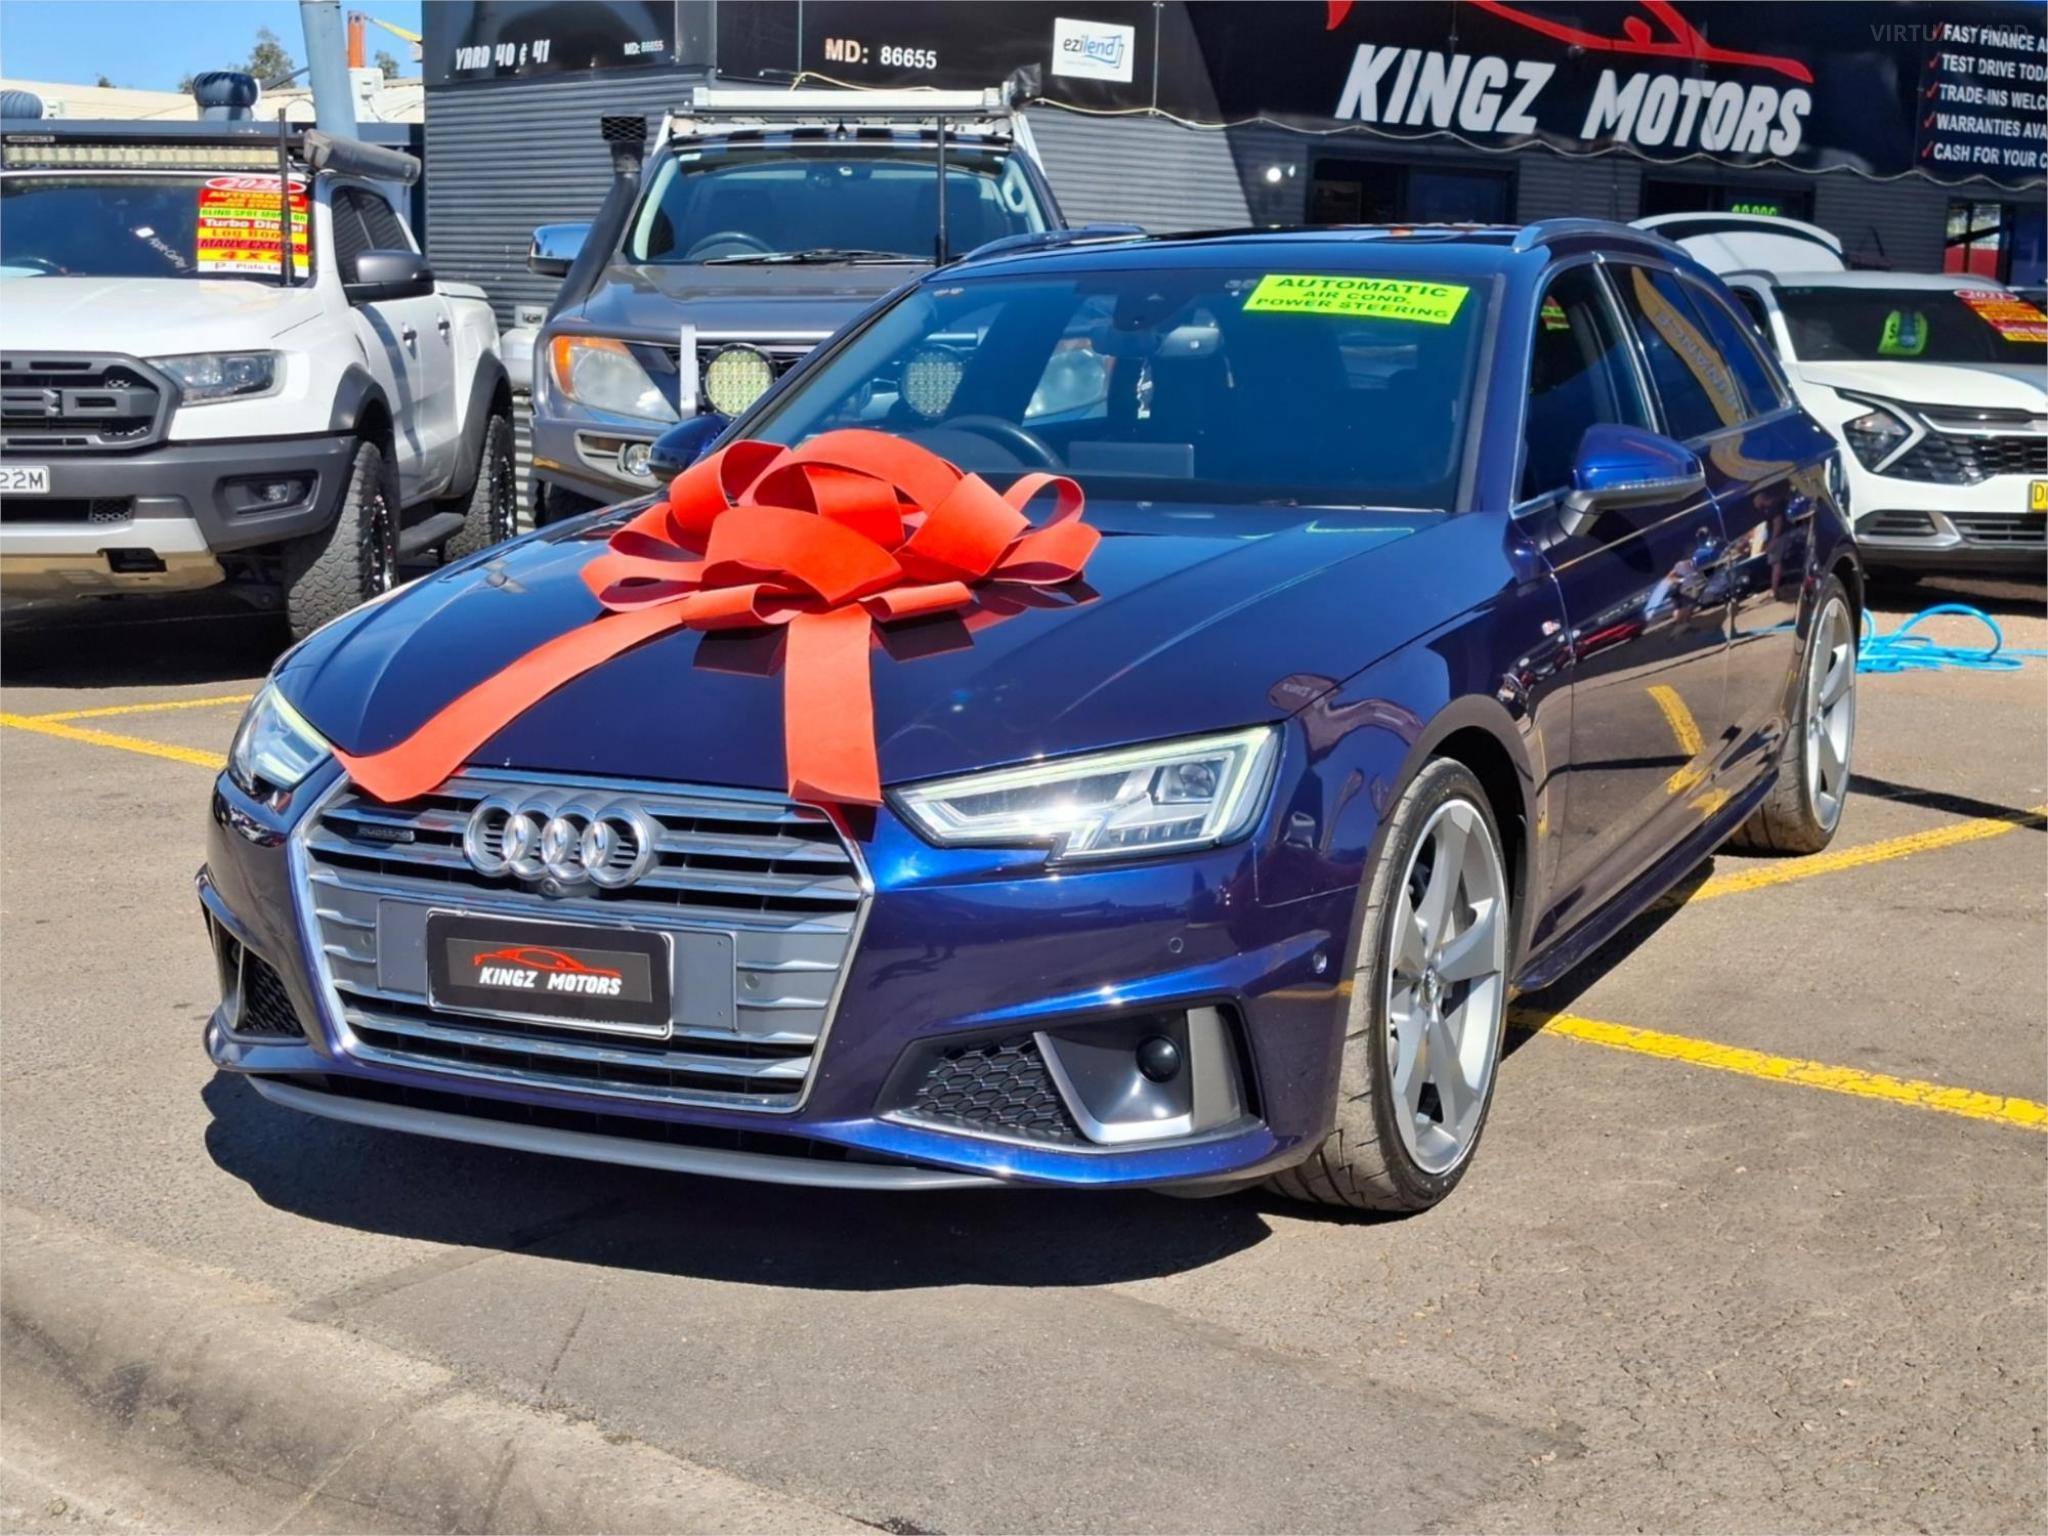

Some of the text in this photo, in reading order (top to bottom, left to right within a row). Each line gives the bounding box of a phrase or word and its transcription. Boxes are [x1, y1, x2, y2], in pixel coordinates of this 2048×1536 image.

[1063, 34, 1116, 57] ezilend
[1943, 24, 2047, 53] FAST FINANCE A
[456, 46, 491, 70] YARD
[495, 43, 516, 66] 40
[532, 39, 551, 63] 41
[824, 38, 937, 70] MD: 86655
[1941, 54, 1975, 73] TEST
[1978, 59, 2016, 78] DRIVE
[1335, 43, 1812, 157] KINGZ MOTORS
[1939, 84, 2047, 111] TRADE-INS WELC
[1936, 113, 2021, 137] WARRANTIES
[1933, 143, 1970, 162] CASH
[1973, 147, 2000, 164] FOR
[2003, 150, 2036, 168] YOUR
[208, 191, 299, 202] AUTOMATC
[254, 221, 303, 232] Dieel
[1275, 278, 1449, 298] AUTOMATIC
[1303, 289, 1411, 305] AIR COND.
[1256, 298, 1449, 318] POWER STEERING
[2034, 484, 2047, 503] D
[479, 966, 622, 995] KINGZ MOTORS
